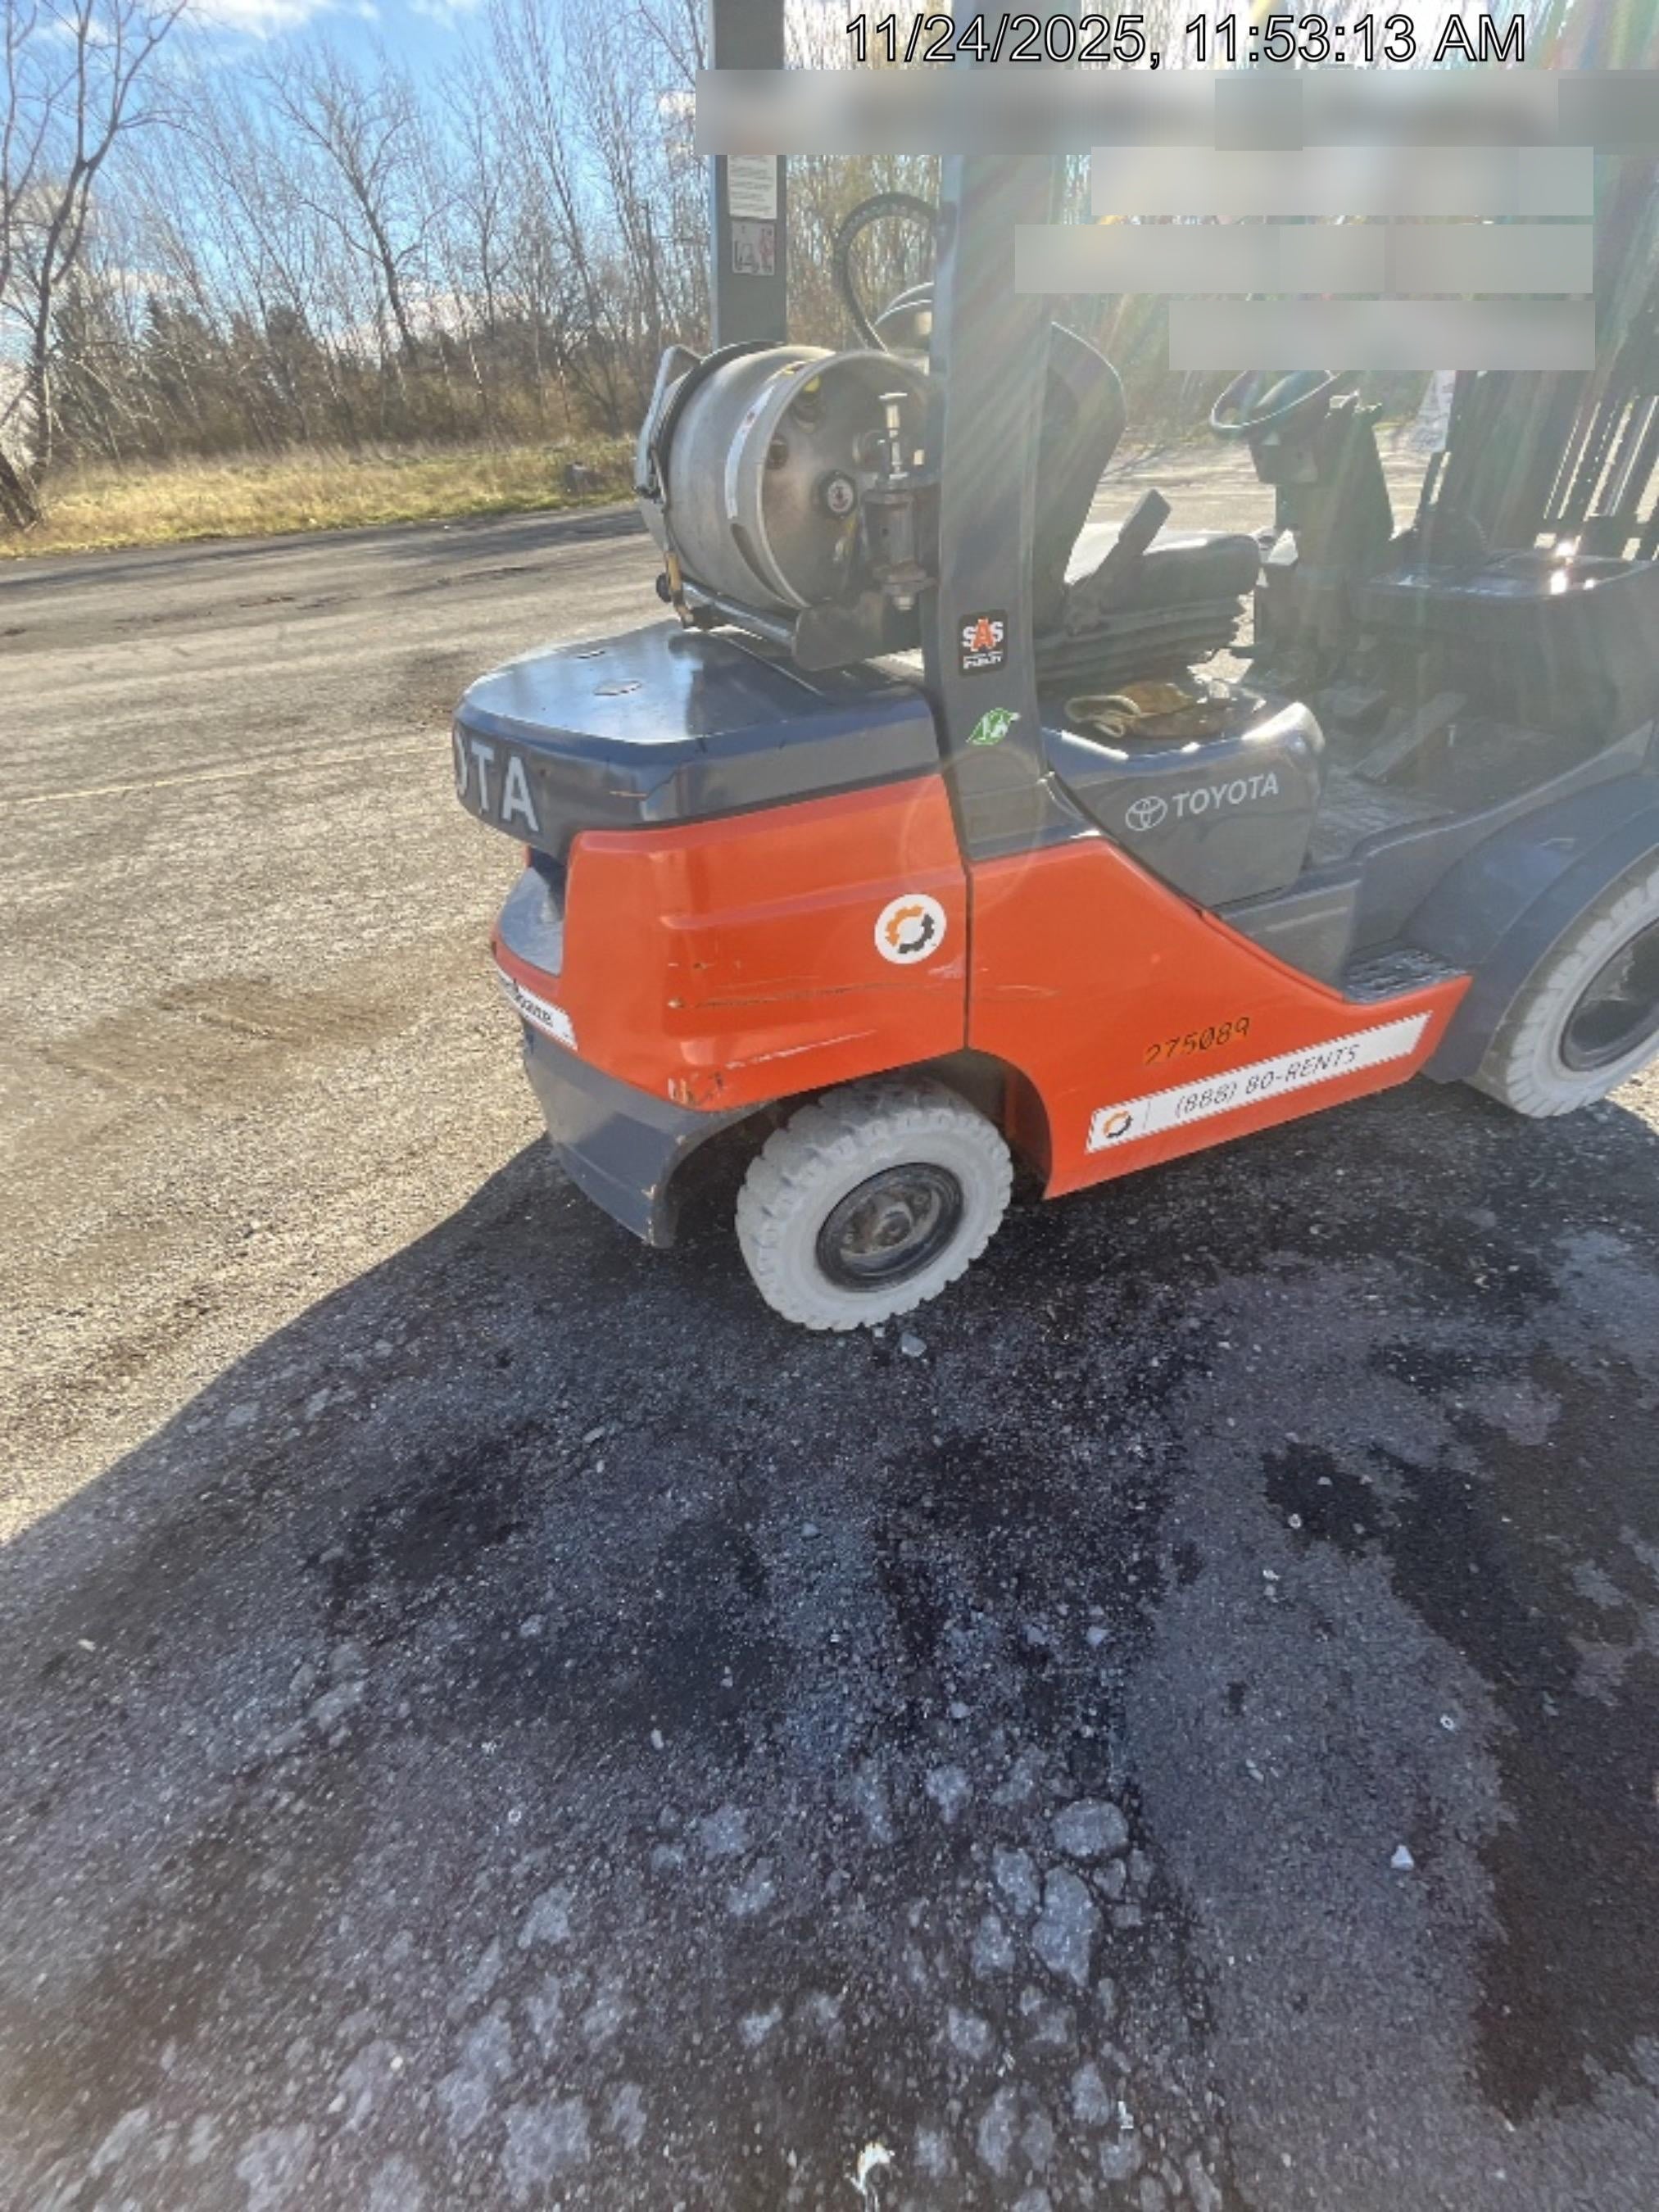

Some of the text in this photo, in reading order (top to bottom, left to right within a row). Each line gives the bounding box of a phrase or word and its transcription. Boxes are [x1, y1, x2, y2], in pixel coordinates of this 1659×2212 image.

[962, 616, 1004, 652] SAS
[1172, 772, 1280, 818] TOYOTA
[1145, 1016, 1250, 1065] 275089
[1175, 1043, 1361, 1119] (888) 80-RENTS
